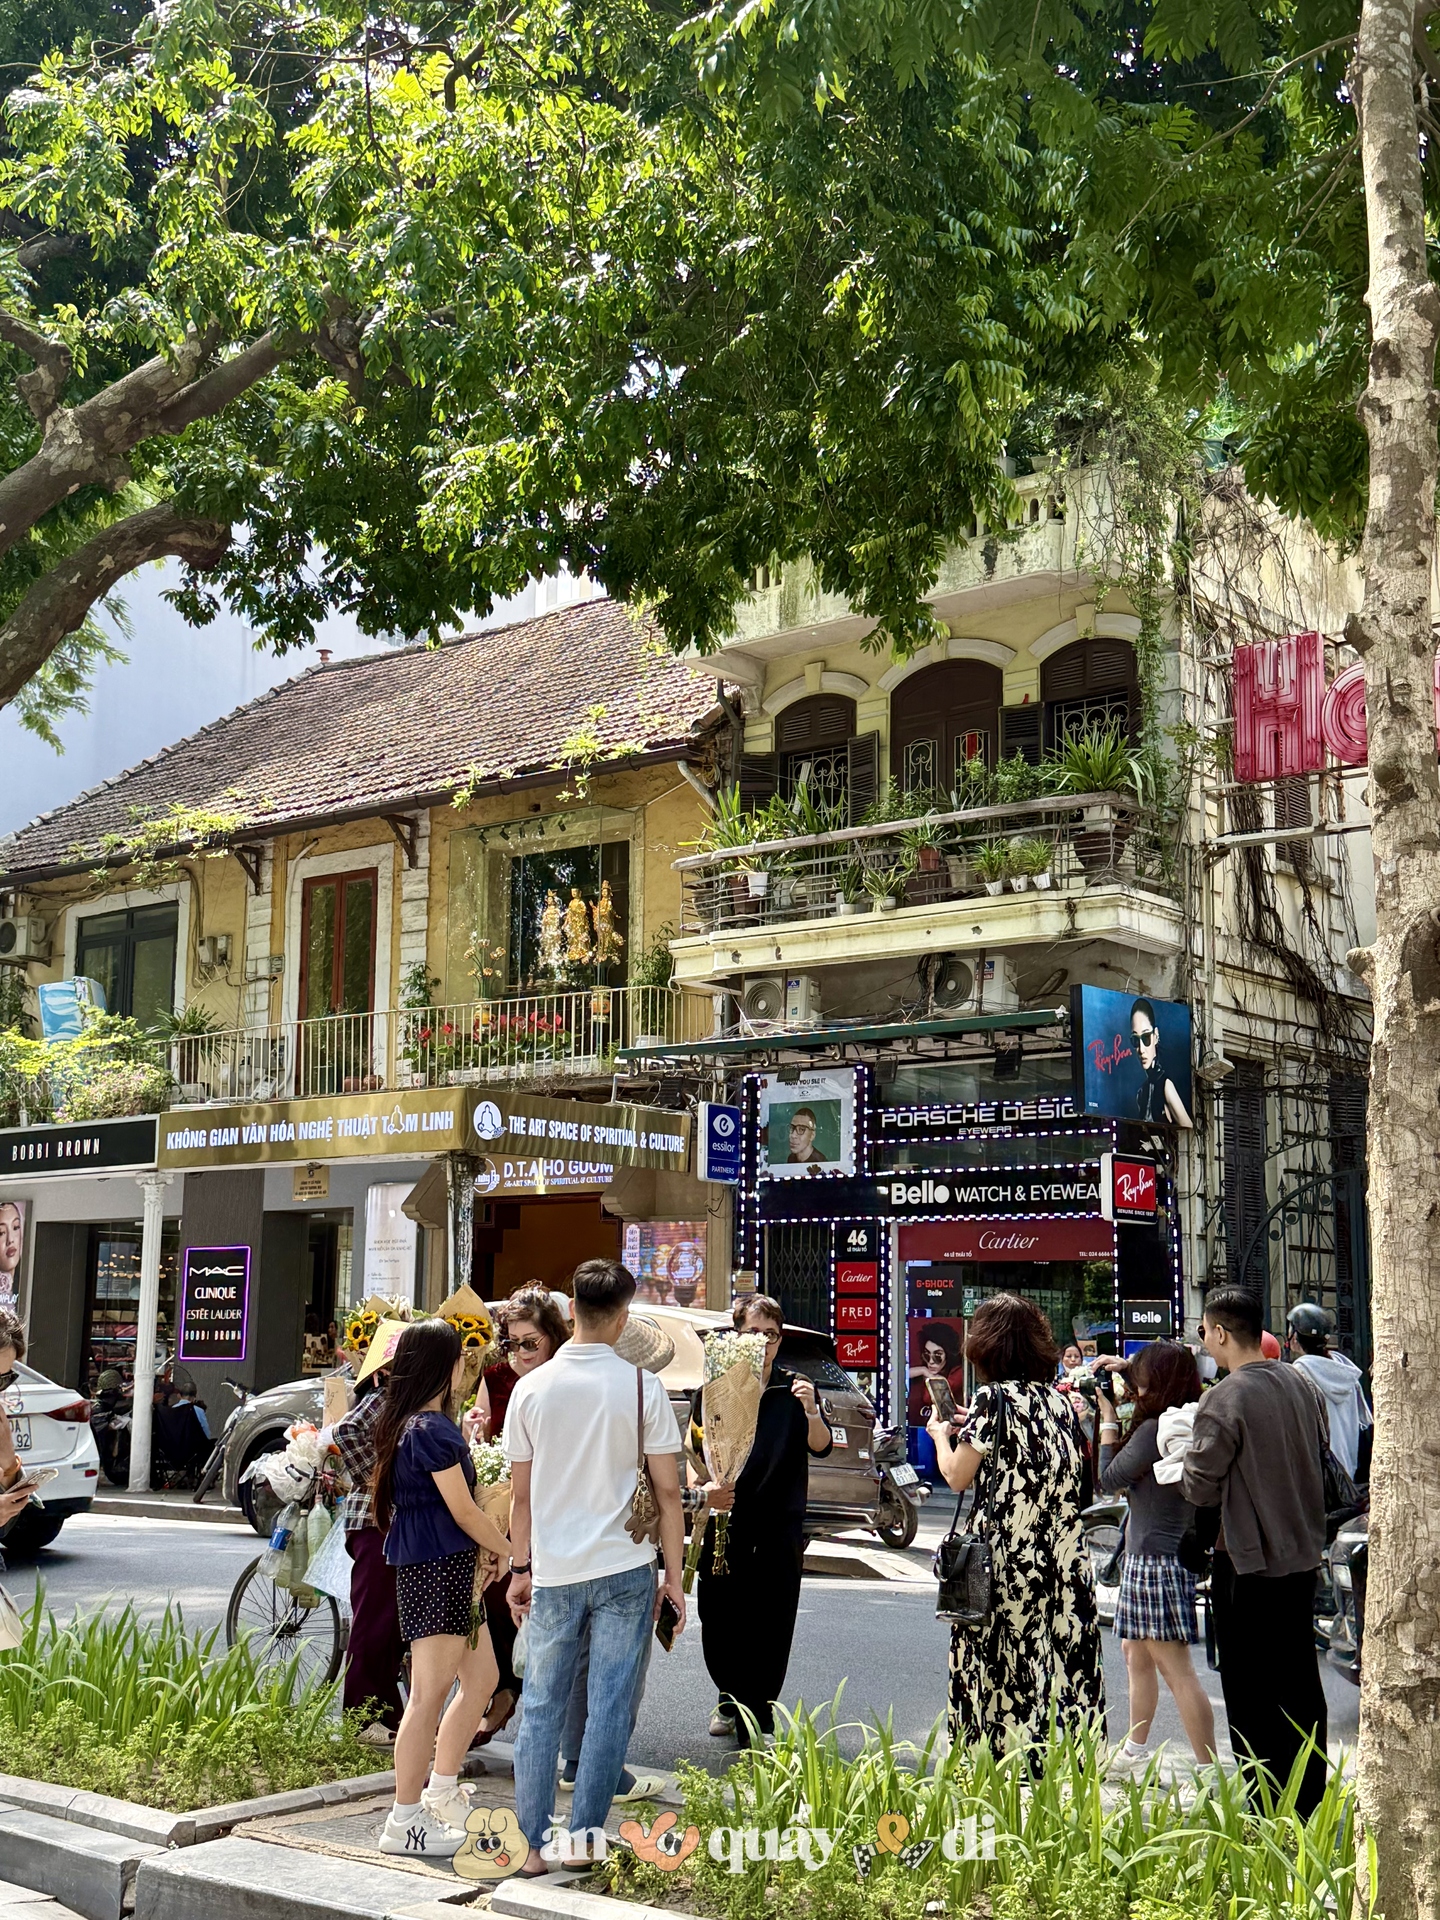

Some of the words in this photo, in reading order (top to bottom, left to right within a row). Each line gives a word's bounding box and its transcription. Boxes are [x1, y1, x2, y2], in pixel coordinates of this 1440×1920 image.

[881, 1107, 996, 1128] PORSCHE
[1002, 1102, 1078, 1122] DESIG
[166, 1127, 207, 1150] KHÔNG
[209, 1127, 239, 1147] GIAN
[241, 1122, 267, 1144] VĂN
[269, 1119, 296, 1142] HÓA
[298, 1116, 334, 1142] NGHỆ
[336, 1113, 379, 1140] THUẬT
[421, 1110, 454, 1132] LINH
[508, 1115, 527, 1135] THE
[528, 1117, 547, 1138] ART
[548, 1119, 579, 1141] SPACE
[580, 1123, 592, 1142] OF
[593, 1125, 638, 1148] SPIRITUAL
[640, 1131, 647, 1149] &
[649, 1132, 685, 1153] CULTURE
[958, 1125, 1013, 1135] EYEWEAR
[12, 1141, 50, 1161] BOBBI
[57, 1138, 100, 1157] BROWN
[712, 1141, 736, 1153] essilor
[711, 1165, 735, 1175] PARTNERS
[891, 1180, 950, 1204] Bello
[954, 1185, 1011, 1203] WATCH
[1014, 1184, 1026, 1201] &
[847, 1229, 868, 1246] 46
[978, 1230, 1040, 1250] Cartier
[841, 1270, 873, 1283] Cartier
[194, 1286, 237, 1300] CLINIQUE
[927, 1289, 943, 1297] Bello
[210, 1309, 243, 1320] LAUDER
[841, 1306, 872, 1320] FRED
[1132, 1310, 1162, 1323] Bello
[185, 1330, 210, 1341] BOBBI
[214, 1330, 242, 1341] BROWN
